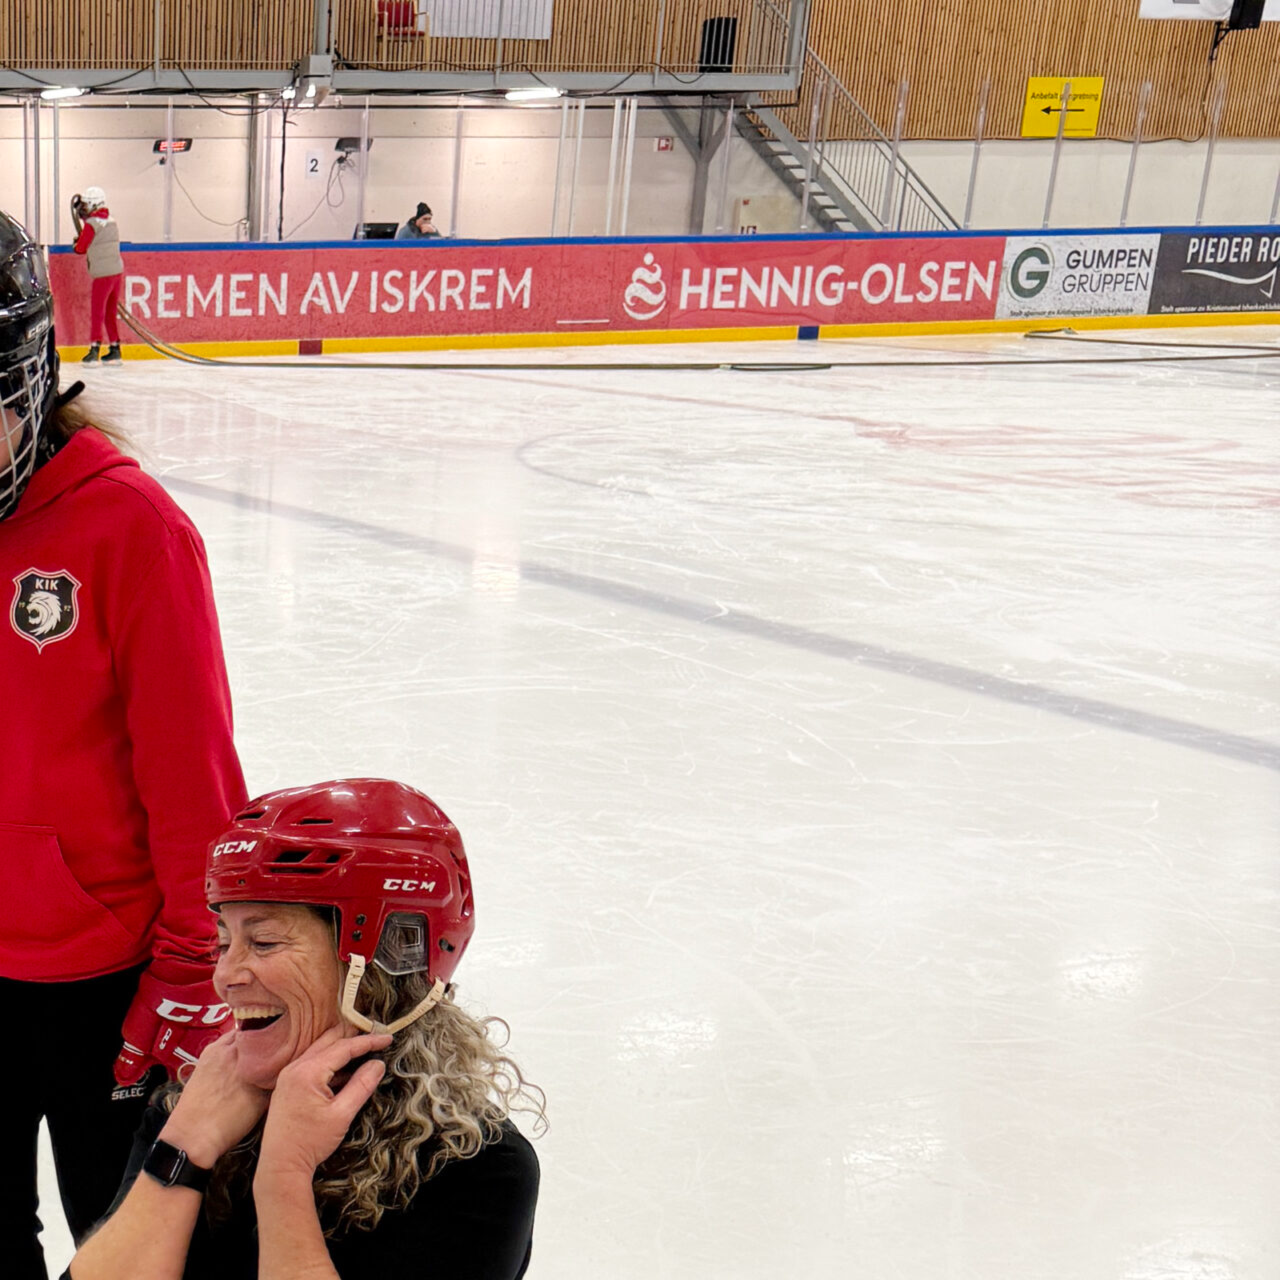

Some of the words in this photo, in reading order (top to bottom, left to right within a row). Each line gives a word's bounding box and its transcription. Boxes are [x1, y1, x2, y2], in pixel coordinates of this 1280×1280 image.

[309, 159, 319, 173] 2
[1066, 249, 1153, 270] GUMPEN
[1187, 237, 1251, 263] PIEDER
[1257, 237, 1280, 261] RO
[679, 260, 997, 310] HENNIG-OLSEN
[1062, 272, 1149, 294] GRUPPEN
[118, 273, 289, 319] REMEN
[300, 271, 359, 315] AV
[369, 267, 533, 314] ISKREM
[35, 578, 59, 591] KIK
[213, 840, 257, 858] CCM
[383, 878, 437, 893] CCM
[111, 1086, 146, 1101] SELEC
